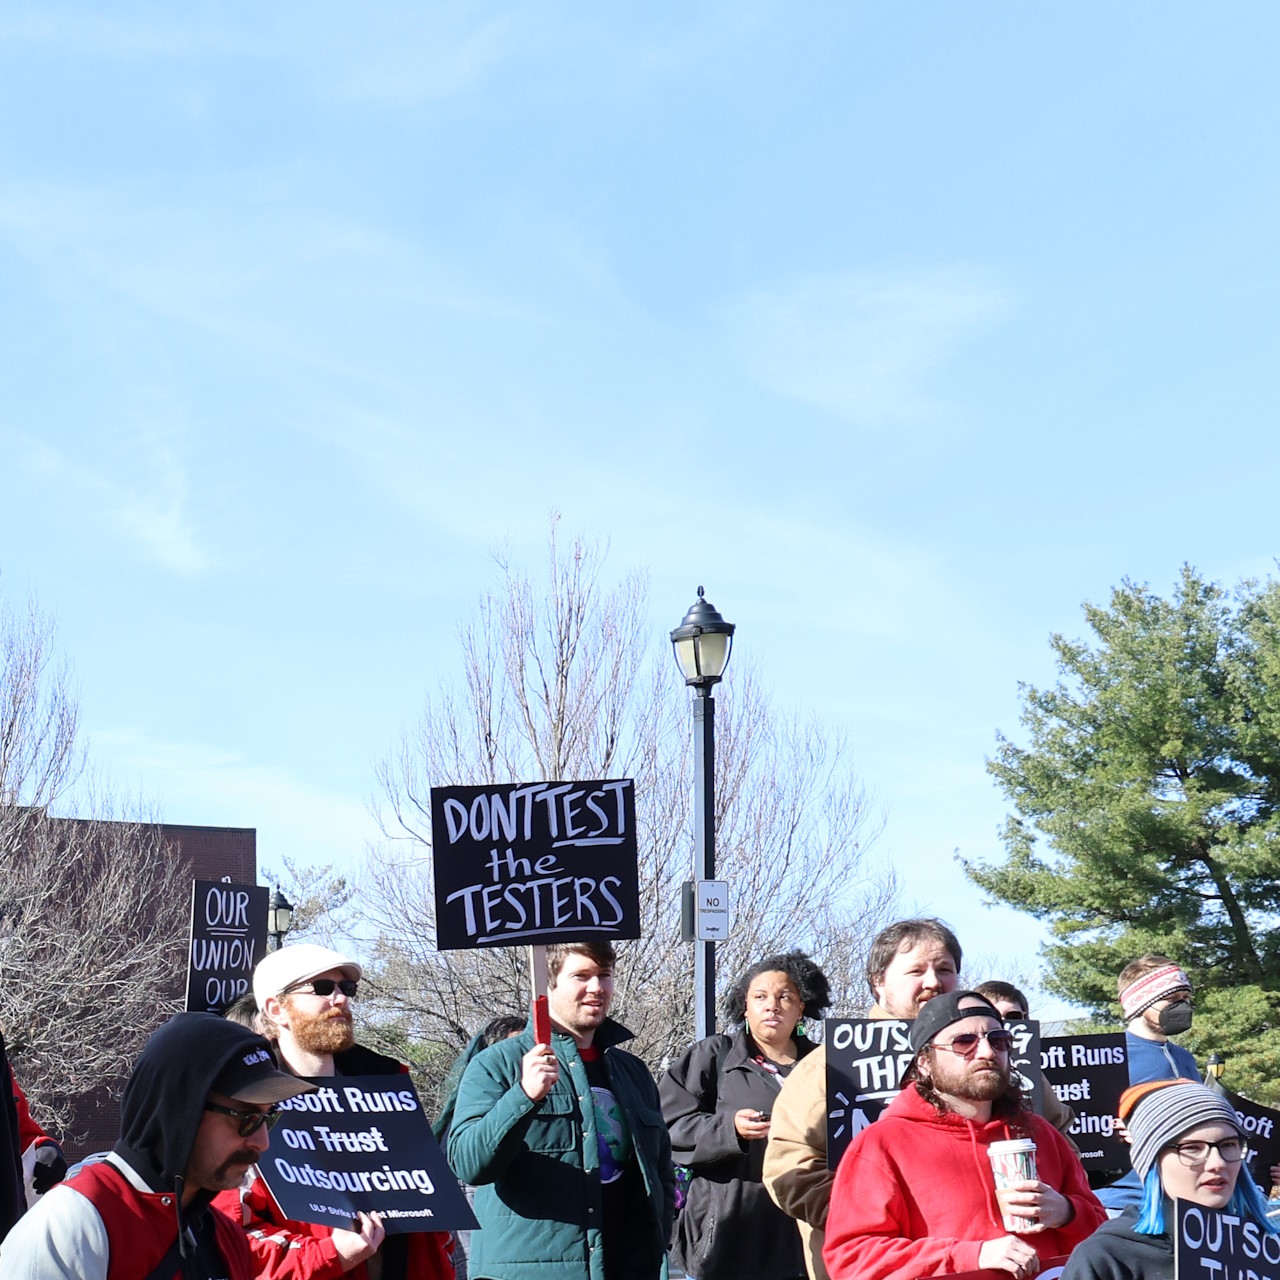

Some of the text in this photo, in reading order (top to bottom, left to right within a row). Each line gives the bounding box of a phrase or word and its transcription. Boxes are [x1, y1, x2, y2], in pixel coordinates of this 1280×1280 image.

[535, 779, 631, 838] TEST
[485, 847, 565, 882] the
[206, 887, 250, 926] OUR
[445, 876, 624, 937] TESTERS
[706, 897, 720, 907] NO
[1071, 1045, 1125, 1067] Runs
[343, 1087, 417, 1113] Runs
[282, 1126, 389, 1152] on Trust
[275, 1157, 435, 1195] Outsourcing
[386, 1208, 434, 1219] Microsoft
